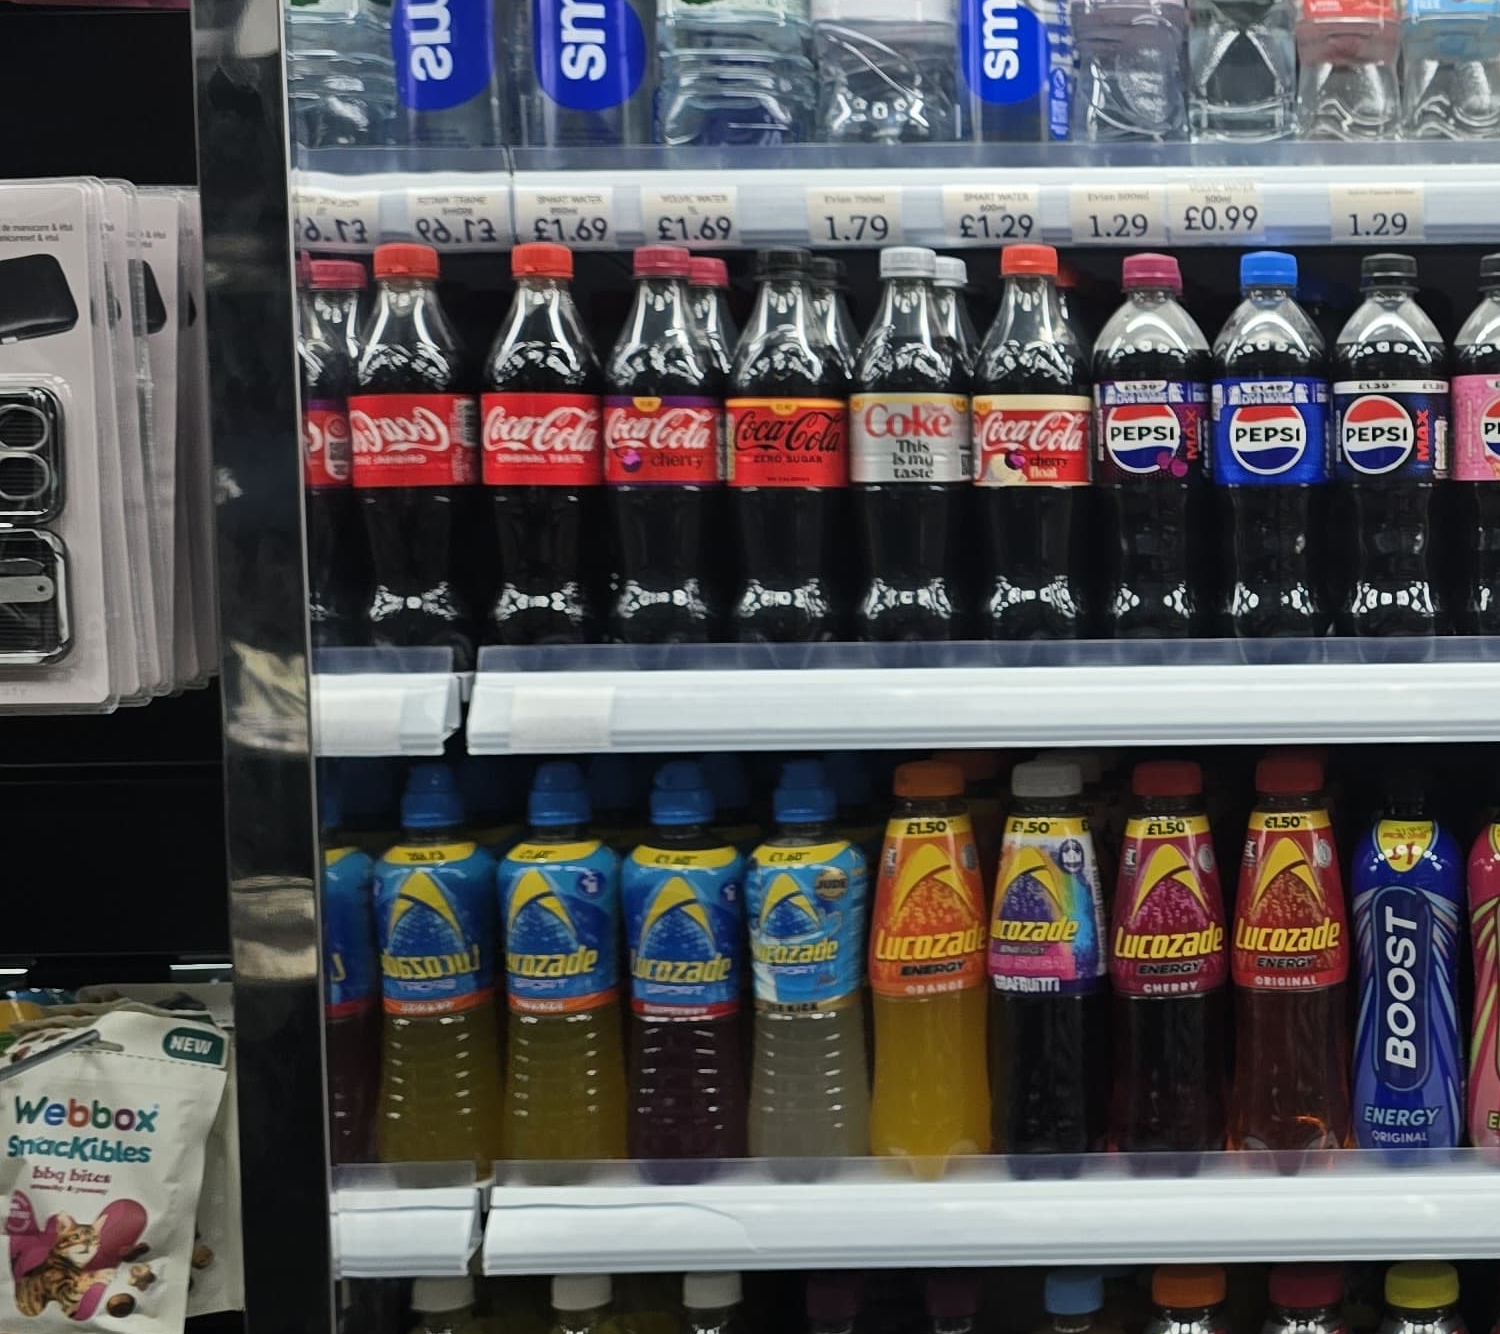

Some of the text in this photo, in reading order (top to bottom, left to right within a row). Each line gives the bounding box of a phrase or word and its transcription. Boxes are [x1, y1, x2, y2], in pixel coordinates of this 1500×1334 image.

[534, 217, 608, 242] £1.69
[657, 218, 731, 241] £1.69
[825, 216, 890, 242] 1.79
[959, 216, 1035, 240] £1.29
[1088, 213, 1149, 239] 1.29
[1184, 205, 1259, 232] £0.99
[1348, 212, 1408, 237] 1.29
[484, 406, 597, 452] Coca-Cola
[605, 407, 713, 450] Coca-Cola
[734, 410, 841, 452] Coca-Cola
[864, 404, 954, 438] Coke
[1110, 423, 1176, 443] PEPSI
[1184, 409, 1198, 461] MAX
[1234, 425, 1302, 444] PEPSI
[1345, 424, 1409, 443] PEPSI
[1416, 409, 1430, 461] MAX
[894, 439, 930, 454] This
[650, 451, 704, 469] cherry
[753, 454, 823, 464] ZERO SUGAR
[893, 466, 935, 480] taste
[906, 819, 947, 835] £1.50
[1263, 814, 1301, 829] £1.50
[875, 922, 986, 962] Lucozade
[1114, 923, 1224, 960] Lucozade
[1234, 916, 1341, 953] Lucozade
[901, 959, 966, 977] ENERGY
[1137, 959, 1201, 976] ENERGY
[1257, 954, 1314, 970] ENERGY
[906, 979, 965, 995] ORANGE
[1142, 981, 1199, 994] CHERRY
[1254, 974, 1318, 987] ORIGINAL
[1385, 905, 1418, 1069] BOOST
[169, 1035, 215, 1057] NEW
[14, 1094, 157, 1133] Webbox
[1363, 1104, 1441, 1126] ENERGY
[1371, 1130, 1428, 1144] ORIGINAL
[32, 1166, 112, 1185] bbq bites
